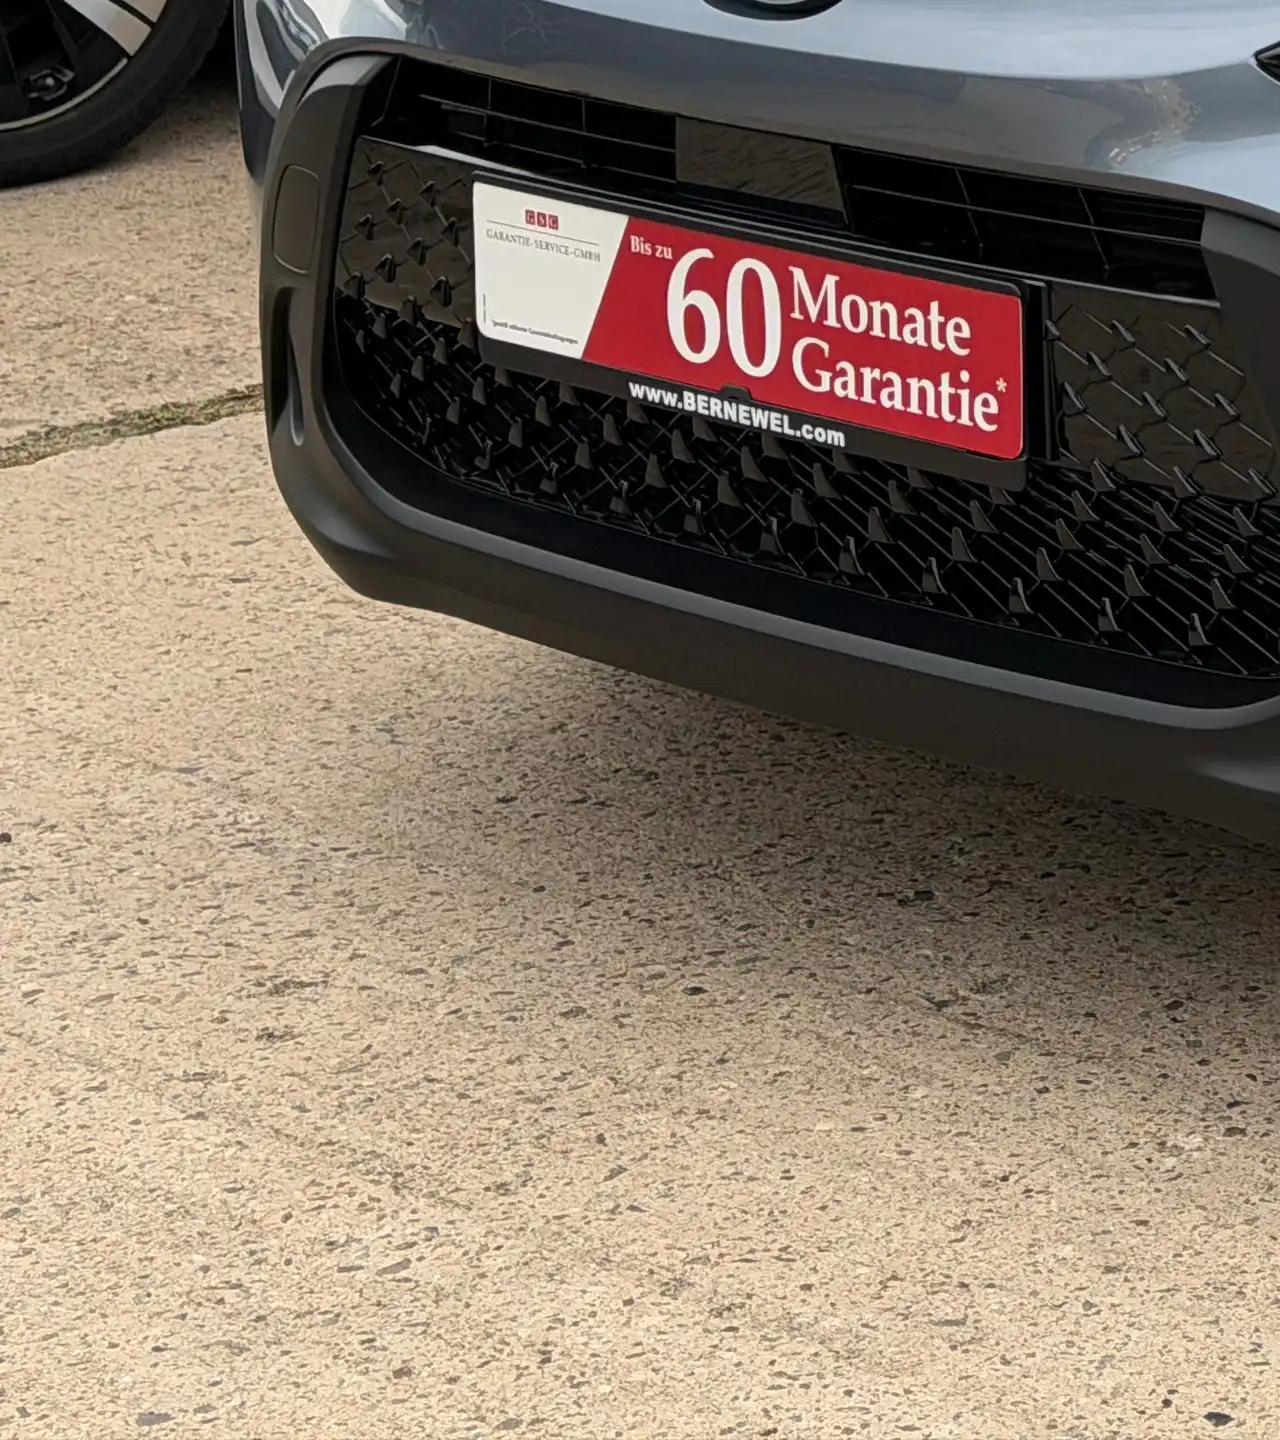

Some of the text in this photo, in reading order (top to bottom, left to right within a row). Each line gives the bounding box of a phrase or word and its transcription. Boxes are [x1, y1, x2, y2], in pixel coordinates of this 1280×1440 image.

[630, 235, 673, 260] Bis zu
[666, 248, 783, 378] 60
[788, 265, 971, 357] Monate
[629, 381, 846, 448] www.BERNEWEL.com
